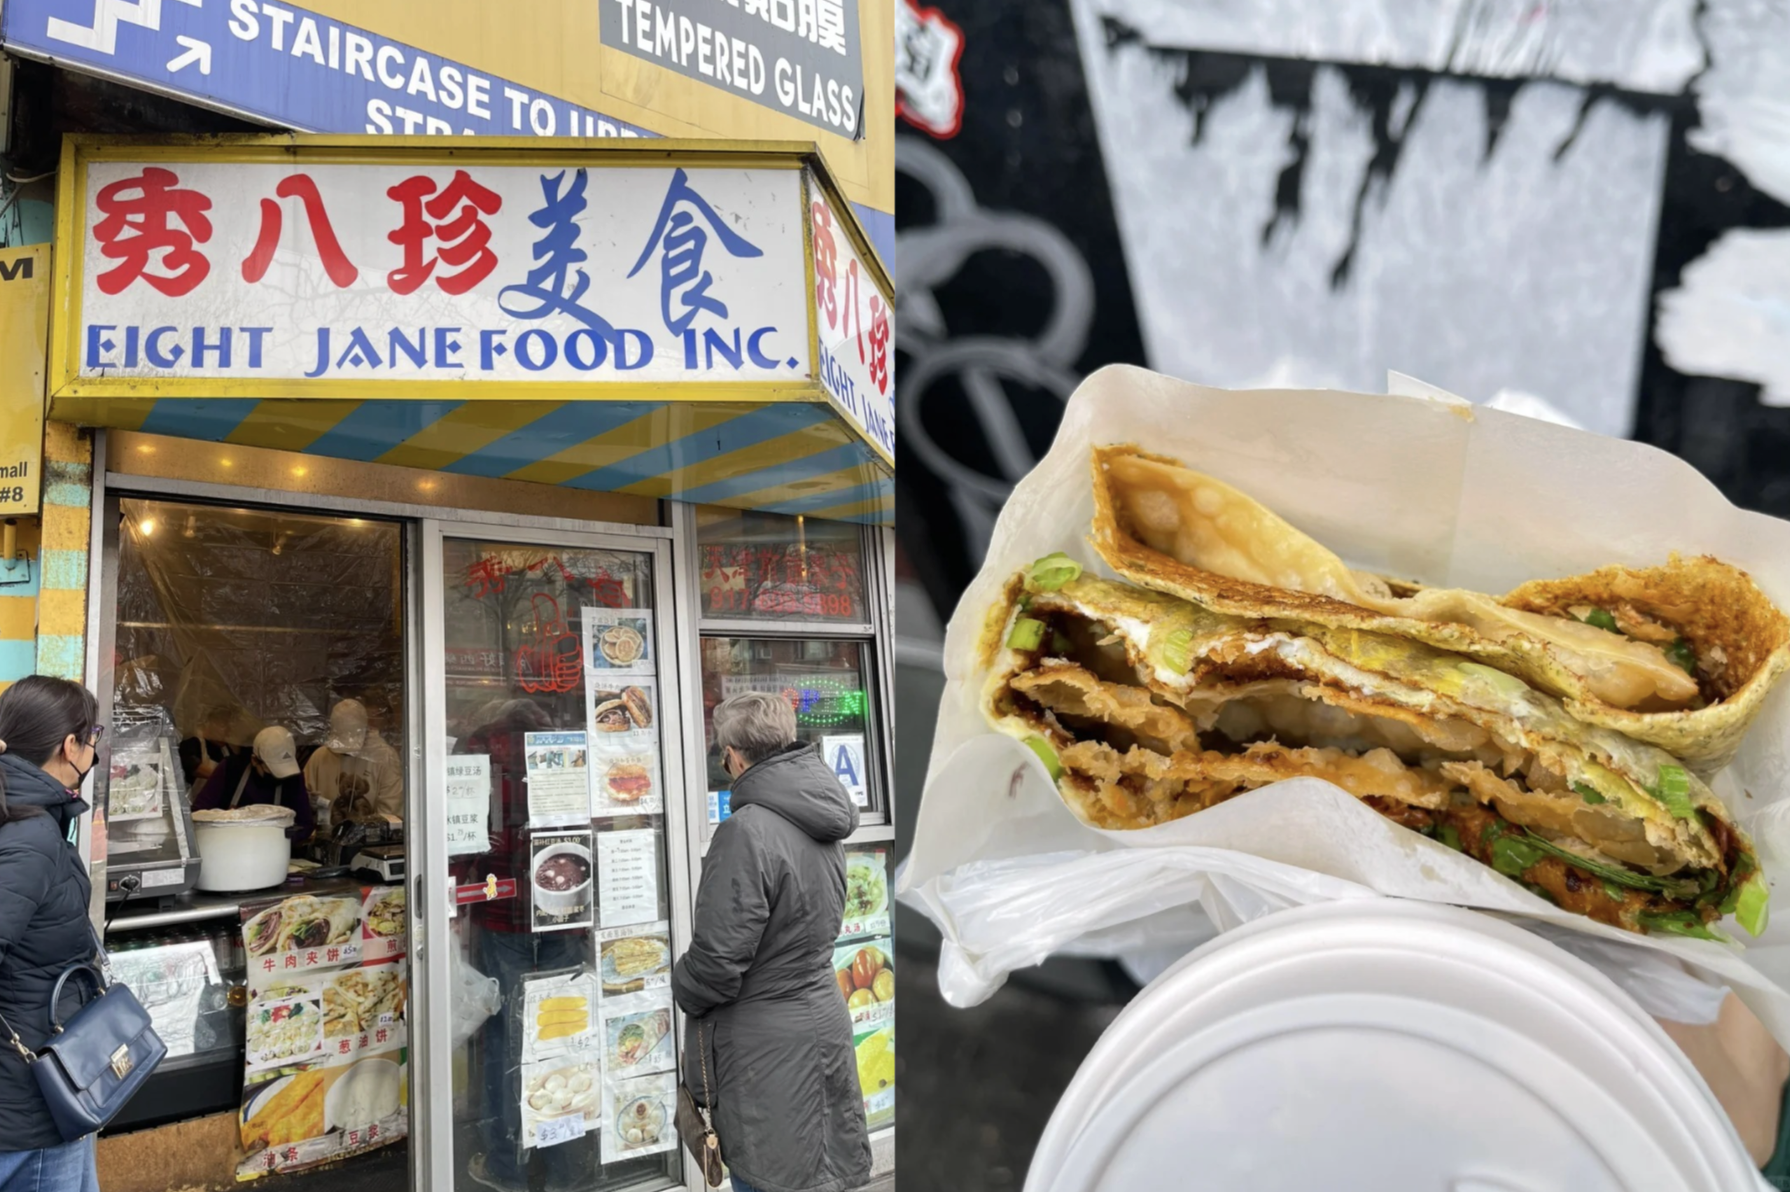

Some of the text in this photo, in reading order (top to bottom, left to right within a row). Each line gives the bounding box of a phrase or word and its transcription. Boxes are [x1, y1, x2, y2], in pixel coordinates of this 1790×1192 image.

[228, 0, 491, 120] STAIRCASE
[504, 86, 556, 137] TO
[615, 0, 856, 132] TEMPERED GLASS
[93, 167, 763, 344] 秀八珍美食
[86, 324, 799, 377] EIGHT JANE FOOD INC.
[819, 342, 891, 452] EIGHT JANE
[0, 486, 23, 502] #8
[835, 745, 860, 786] A
[263, 948, 340, 973] 牛肉夹饼
[338, 1028, 388, 1055] 葱油饼
[348, 1124, 379, 1146] 豆浆
[263, 1146, 298, 1168] 油条
